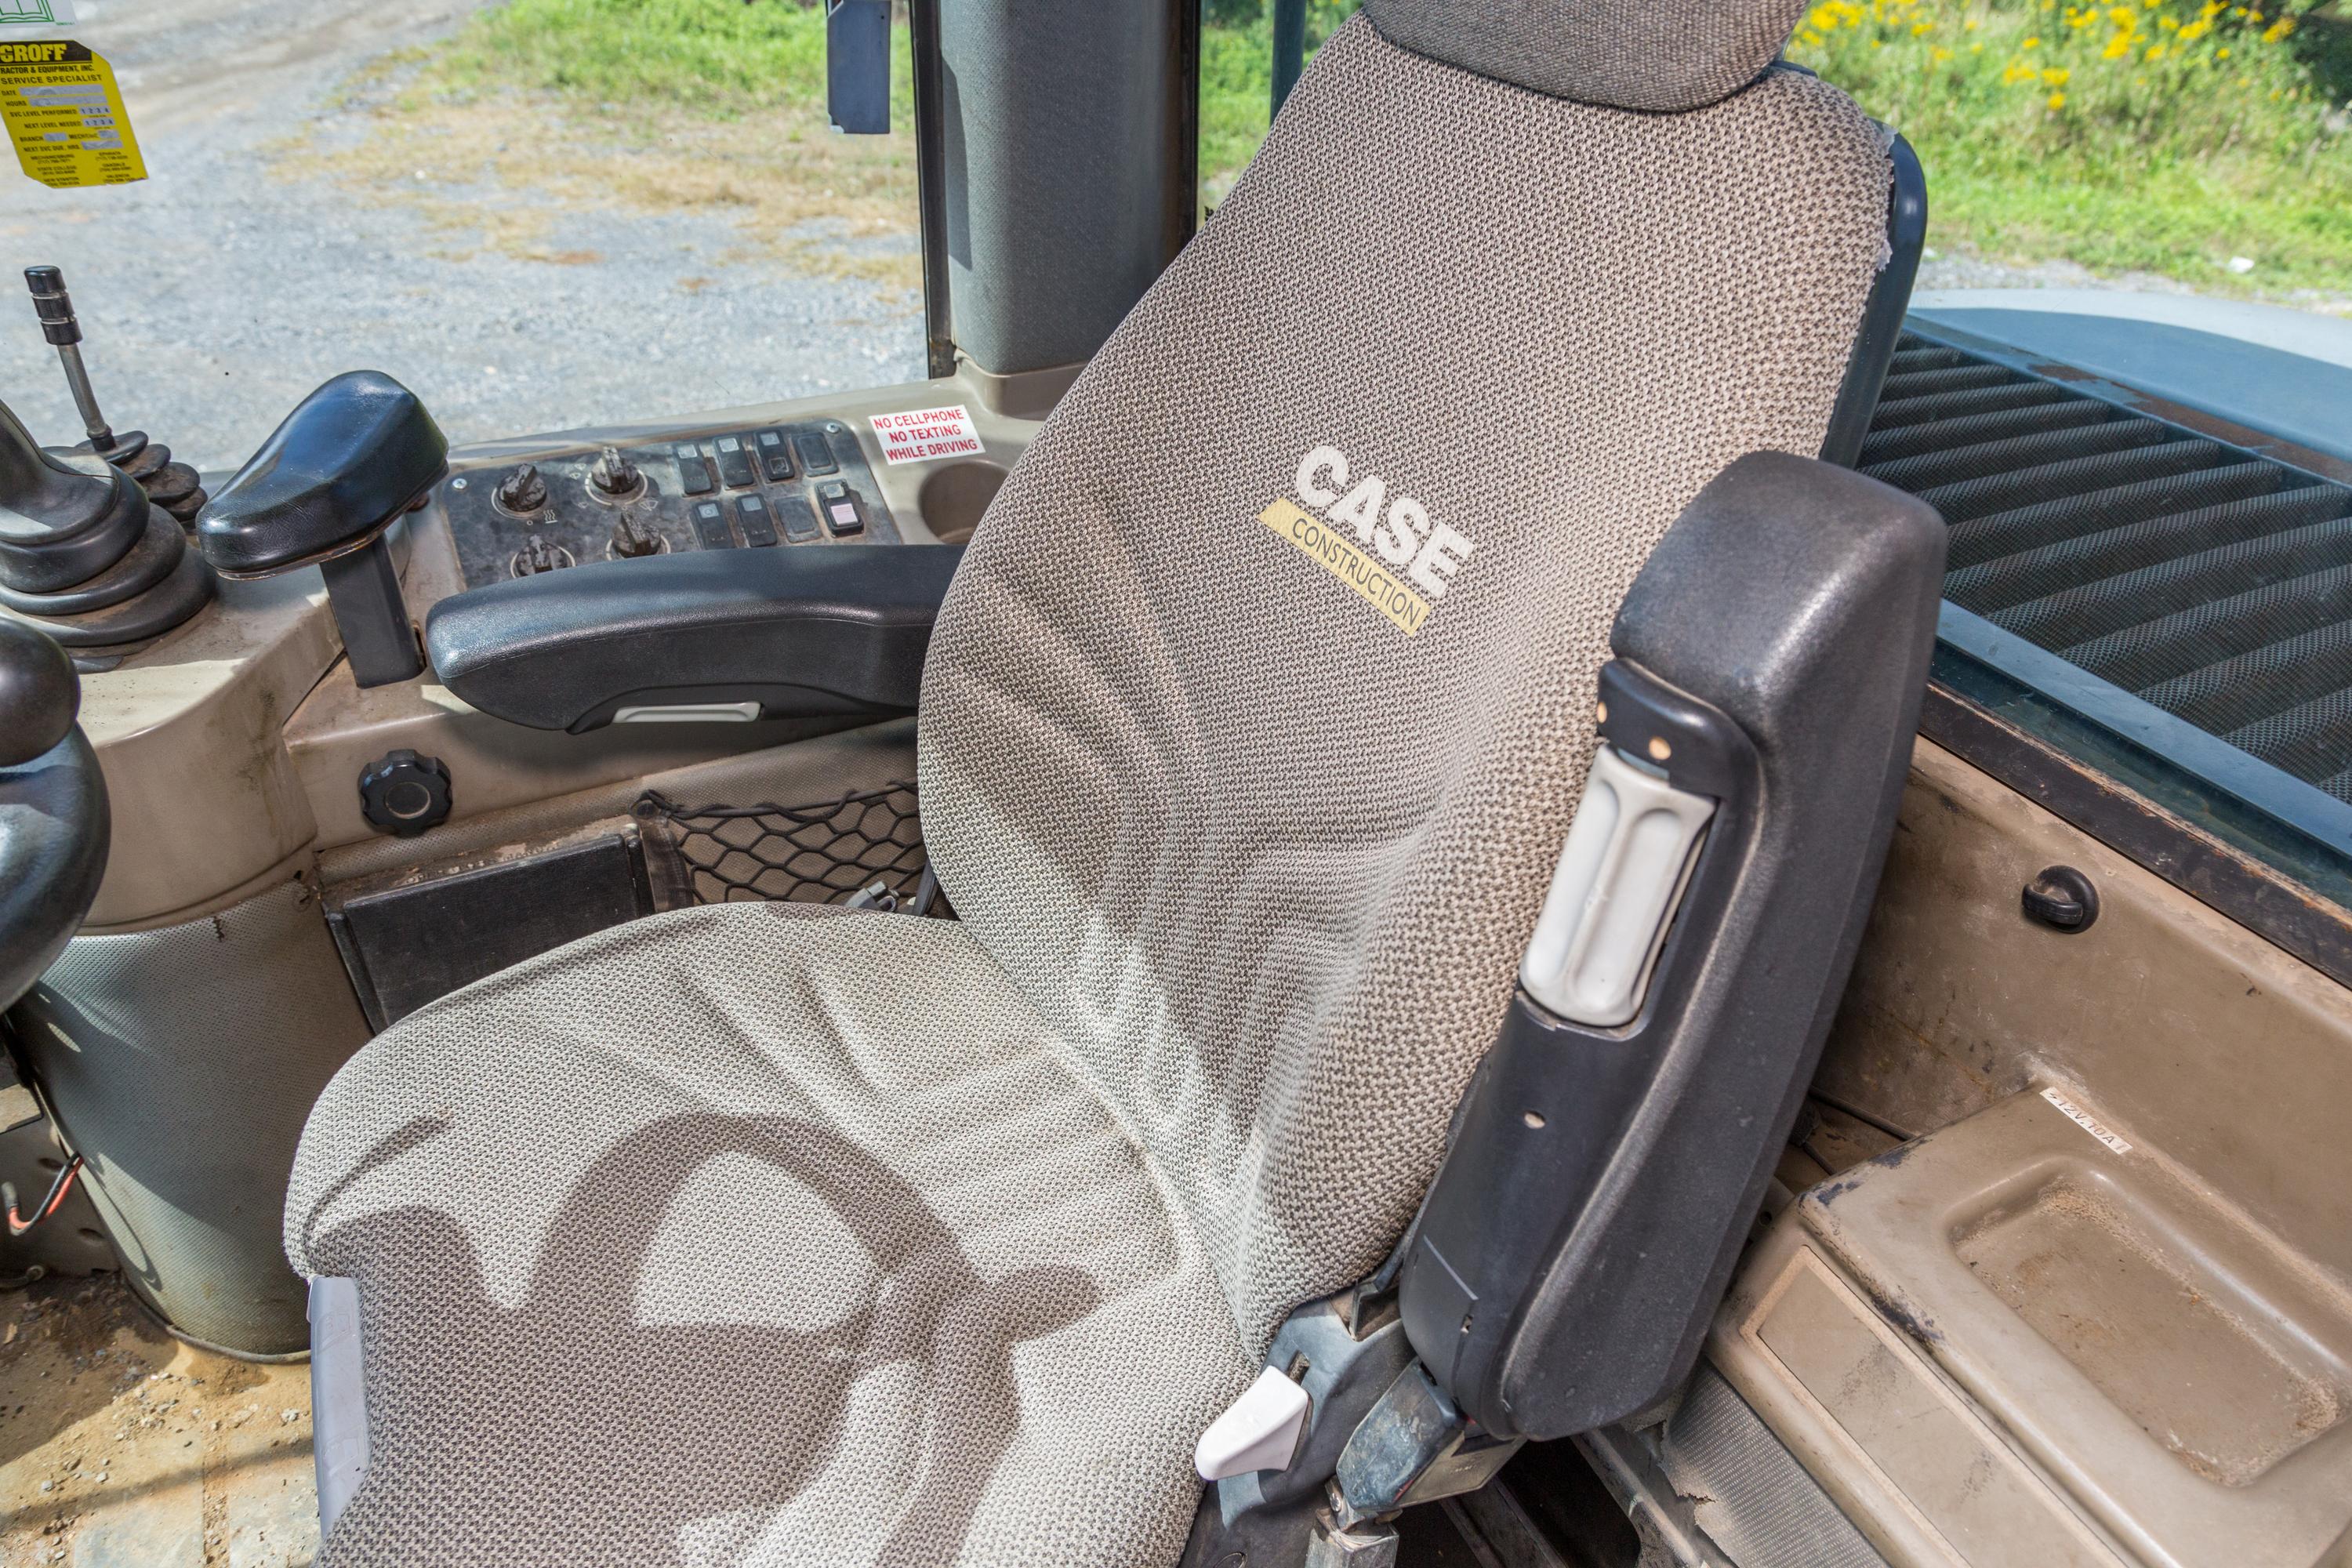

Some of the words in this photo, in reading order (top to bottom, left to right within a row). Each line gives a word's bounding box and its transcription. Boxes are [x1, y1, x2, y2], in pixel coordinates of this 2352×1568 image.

[0, 66, 29, 74] RACTOR
[1, 75, 44, 85] SERVICE
[45, 74, 103, 84] SPECIALIST
[873, 417, 891, 430] NO
[895, 408, 964, 426] CELLPHONE
[888, 431, 908, 444] NO
[909, 424, 962, 441] TEXTING
[886, 445, 927, 461] WHILE
[927, 438, 978, 456] DRIVING
[1295, 445, 1475, 598] CASE
[1292, 517, 1421, 627] CONSTRUCTION
